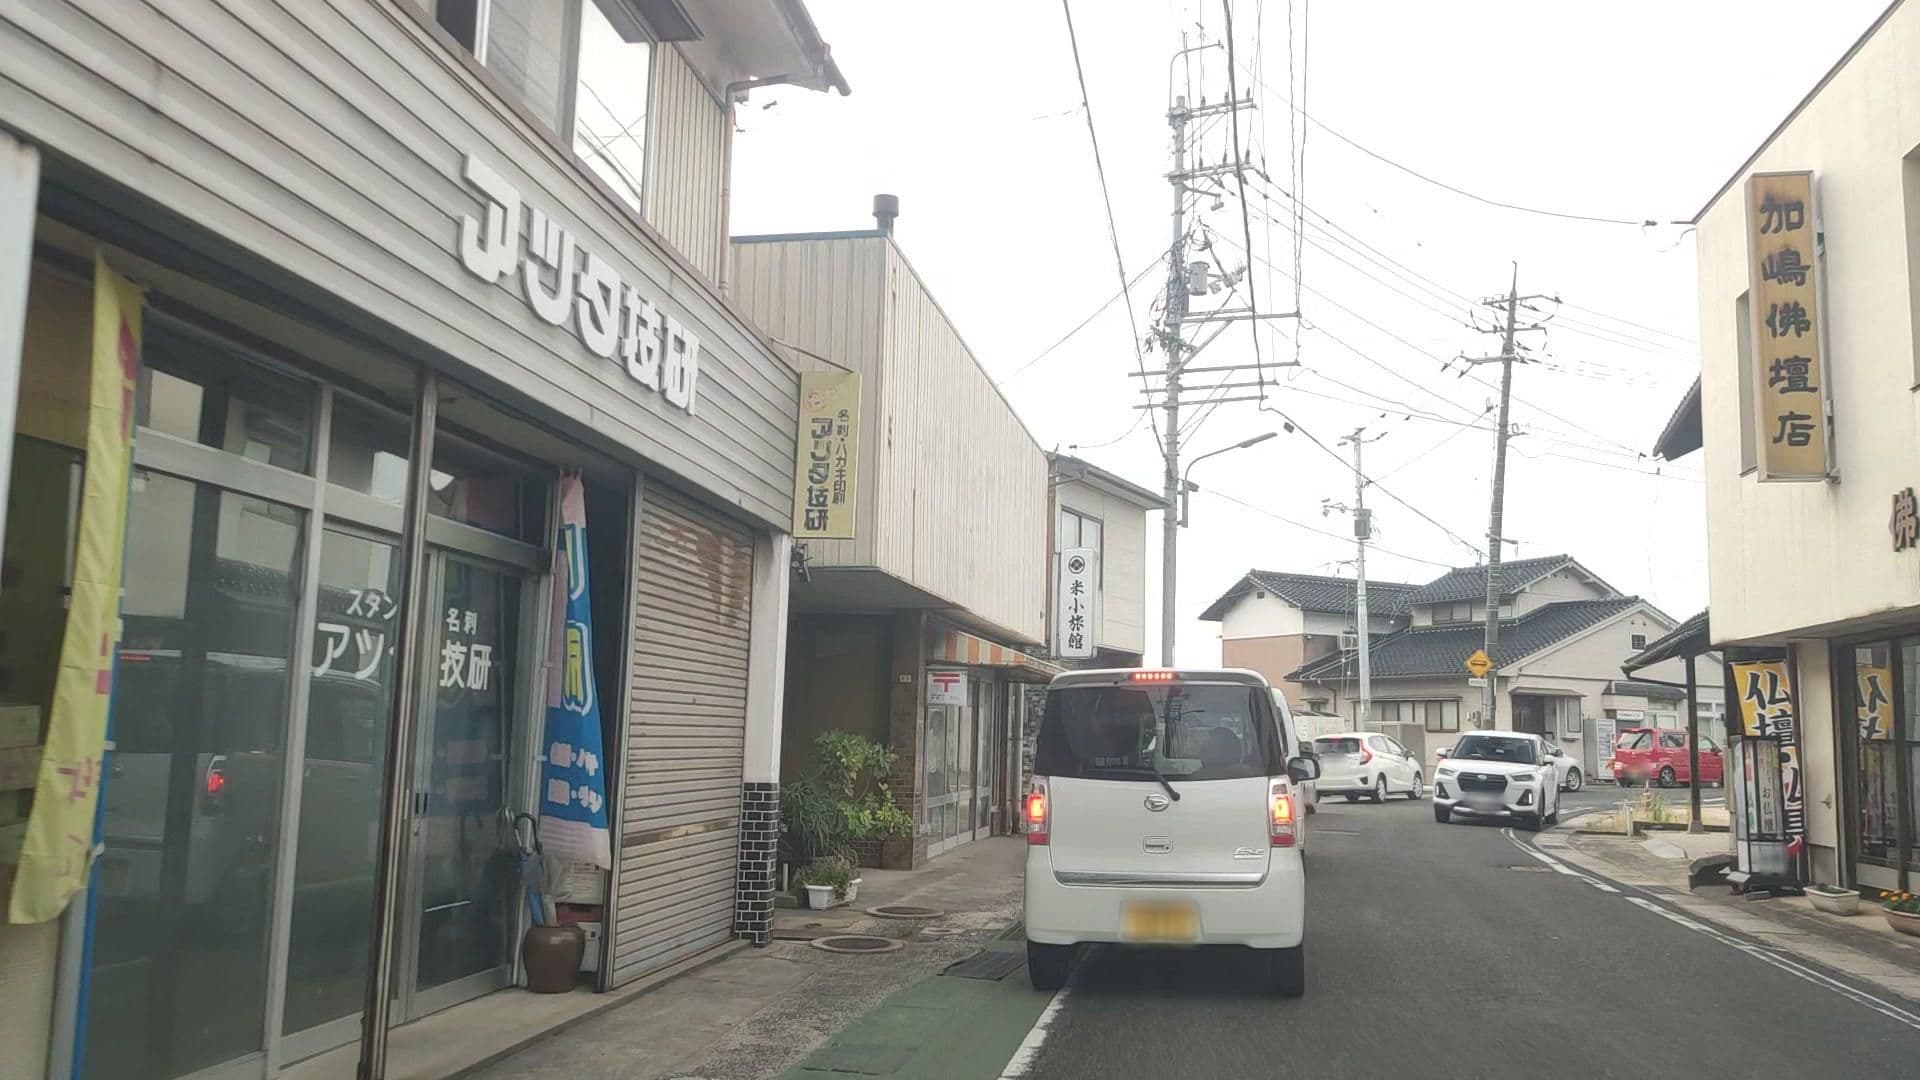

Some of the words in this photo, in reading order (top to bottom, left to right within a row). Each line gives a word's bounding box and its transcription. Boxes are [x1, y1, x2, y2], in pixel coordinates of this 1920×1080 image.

[462, 153, 699, 417] アツタ技研
[1759, 191, 1818, 447] 加嶋佛壇店
[804, 417, 834, 532] アツタ技研
[314, 622, 395, 680] アツ
[439, 639, 492, 691] 技研
[1067, 579, 1085, 650] 米小旅館
